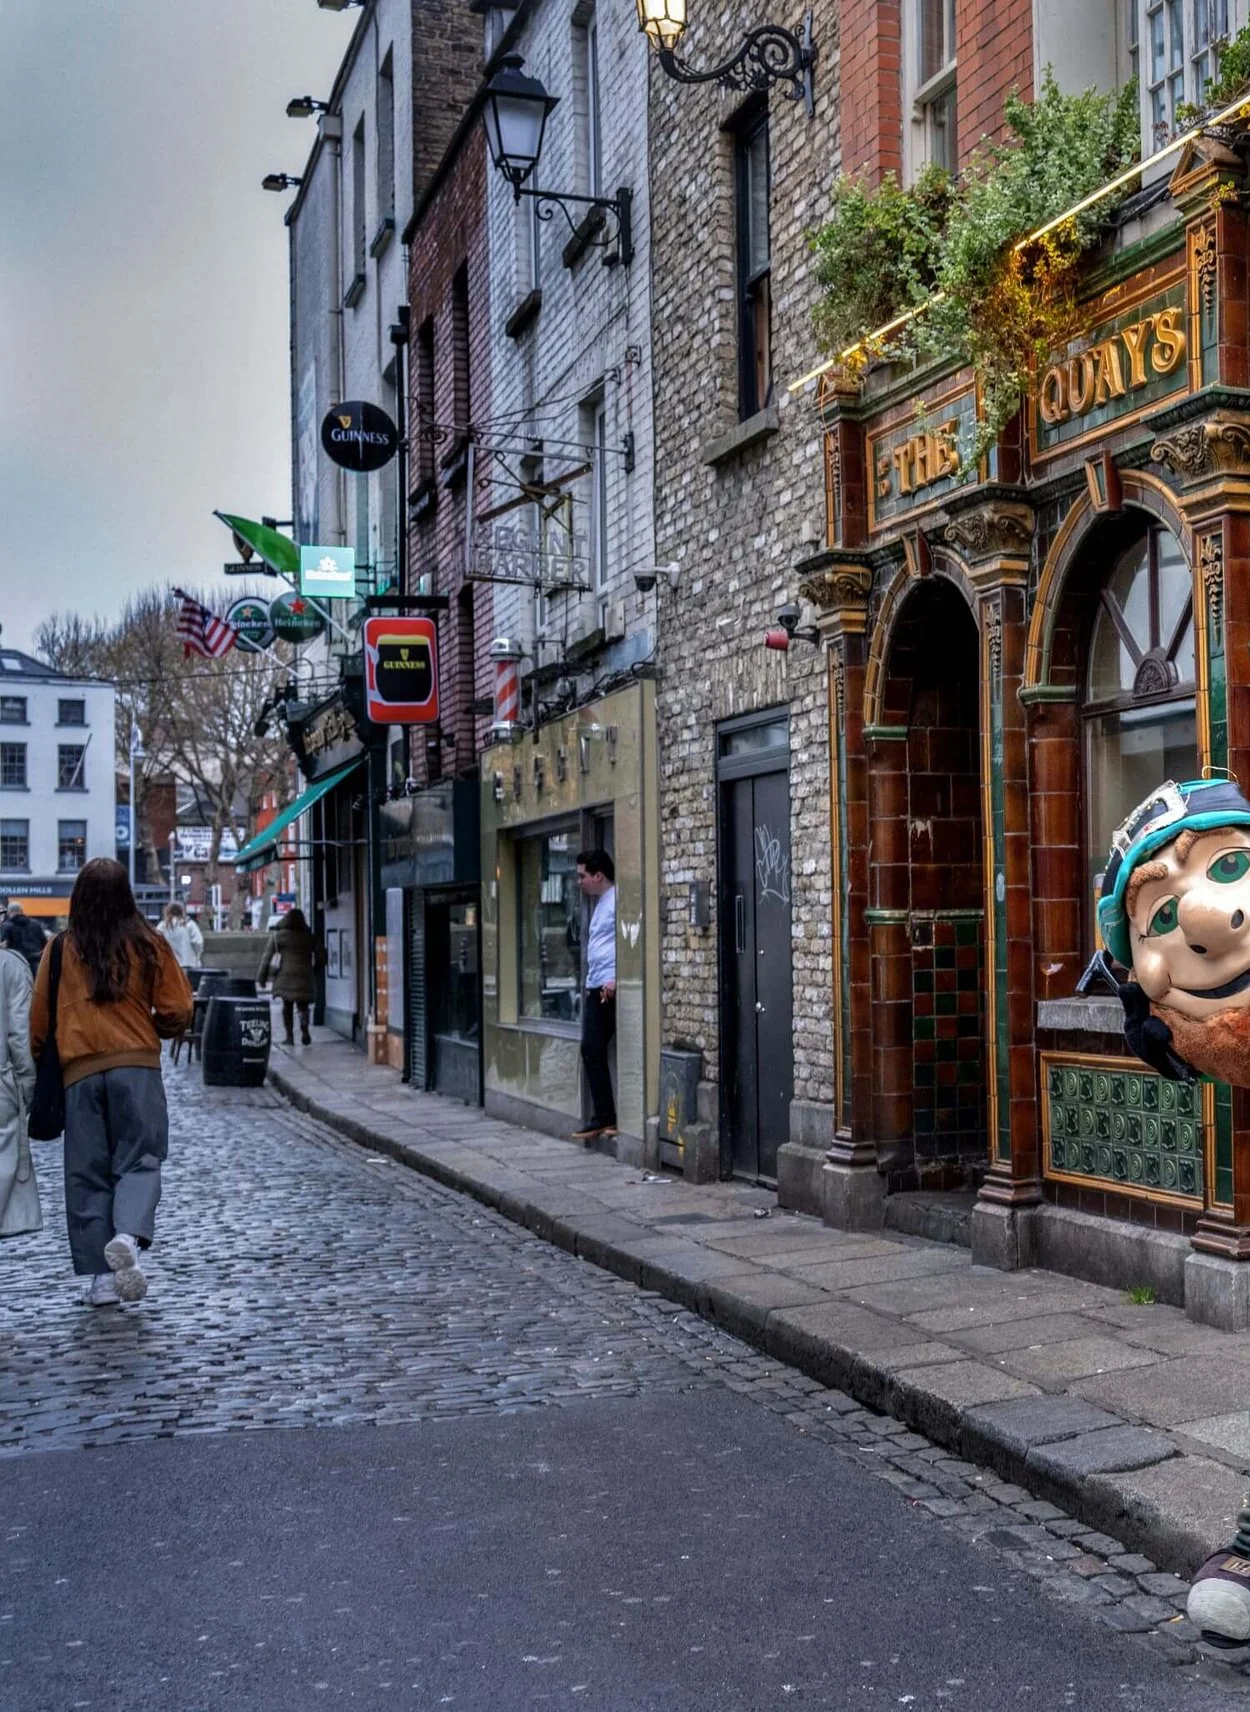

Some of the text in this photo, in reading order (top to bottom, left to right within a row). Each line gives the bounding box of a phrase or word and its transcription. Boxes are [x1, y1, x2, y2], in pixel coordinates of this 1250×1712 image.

[893, 417, 960, 496] THE
[1039, 307, 1186, 425] QUAYS
[330, 427, 390, 446] GUINNESS
[230, 618, 268, 628] eineken
[274, 617, 320, 628] Heineken
[383, 660, 426, 670] GUINNESS
[30, 885, 53, 895] MILLS
